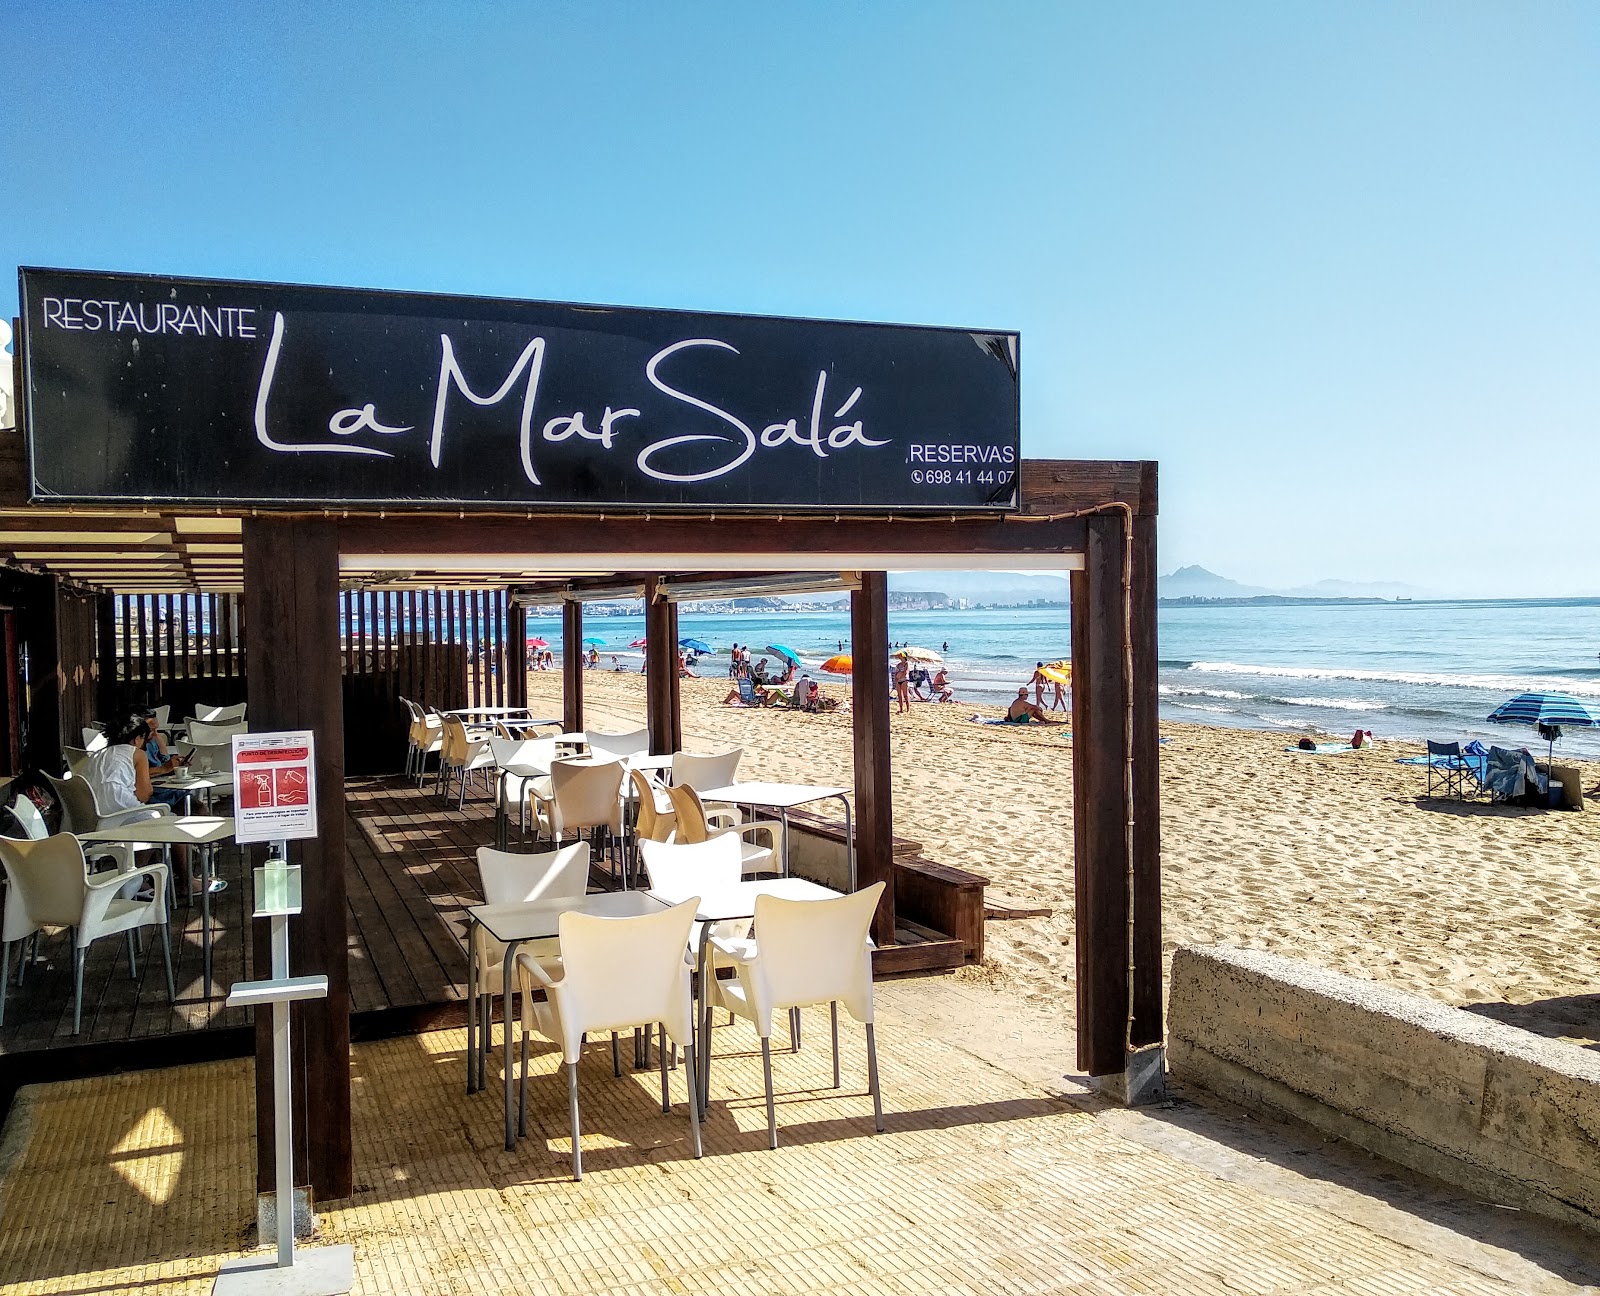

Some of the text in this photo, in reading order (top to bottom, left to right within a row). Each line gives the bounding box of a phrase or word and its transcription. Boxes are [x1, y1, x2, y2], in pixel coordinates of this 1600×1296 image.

[42, 297, 257, 339] RESTAURANTE
[254, 311, 892, 485] La Mar Salá
[910, 444, 1015, 464] RESERVAS
[926, 469, 1015, 485] 698 41 44 07
